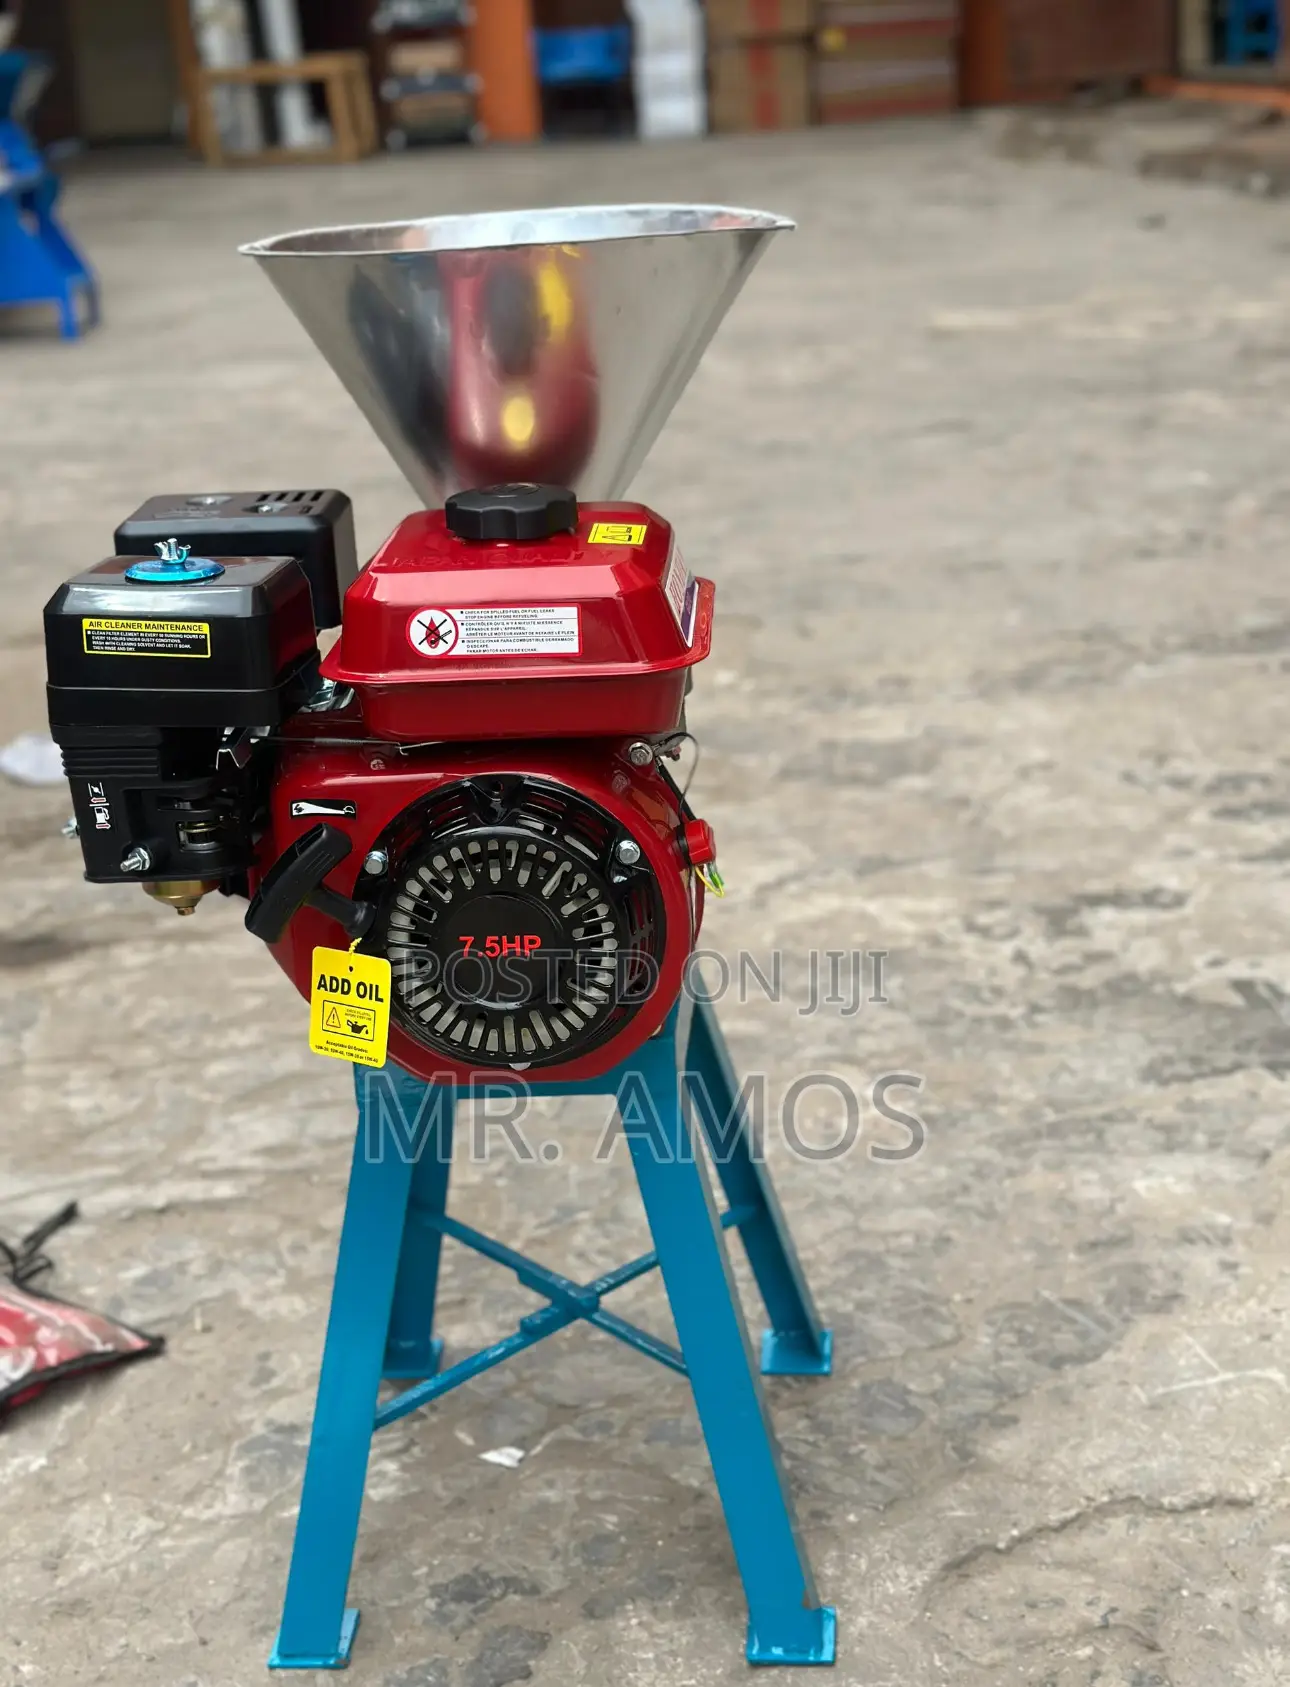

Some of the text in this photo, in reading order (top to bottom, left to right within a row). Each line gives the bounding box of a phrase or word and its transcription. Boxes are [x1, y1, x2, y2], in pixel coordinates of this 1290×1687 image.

[104, 622, 142, 630] CLEANER
[145, 623, 204, 632] MAINTENANCE
[458, 935, 542, 958] 7.5HP
[317, 974, 384, 1003] ADD OIL
[326, 1040, 347, 1048] Acceptable
